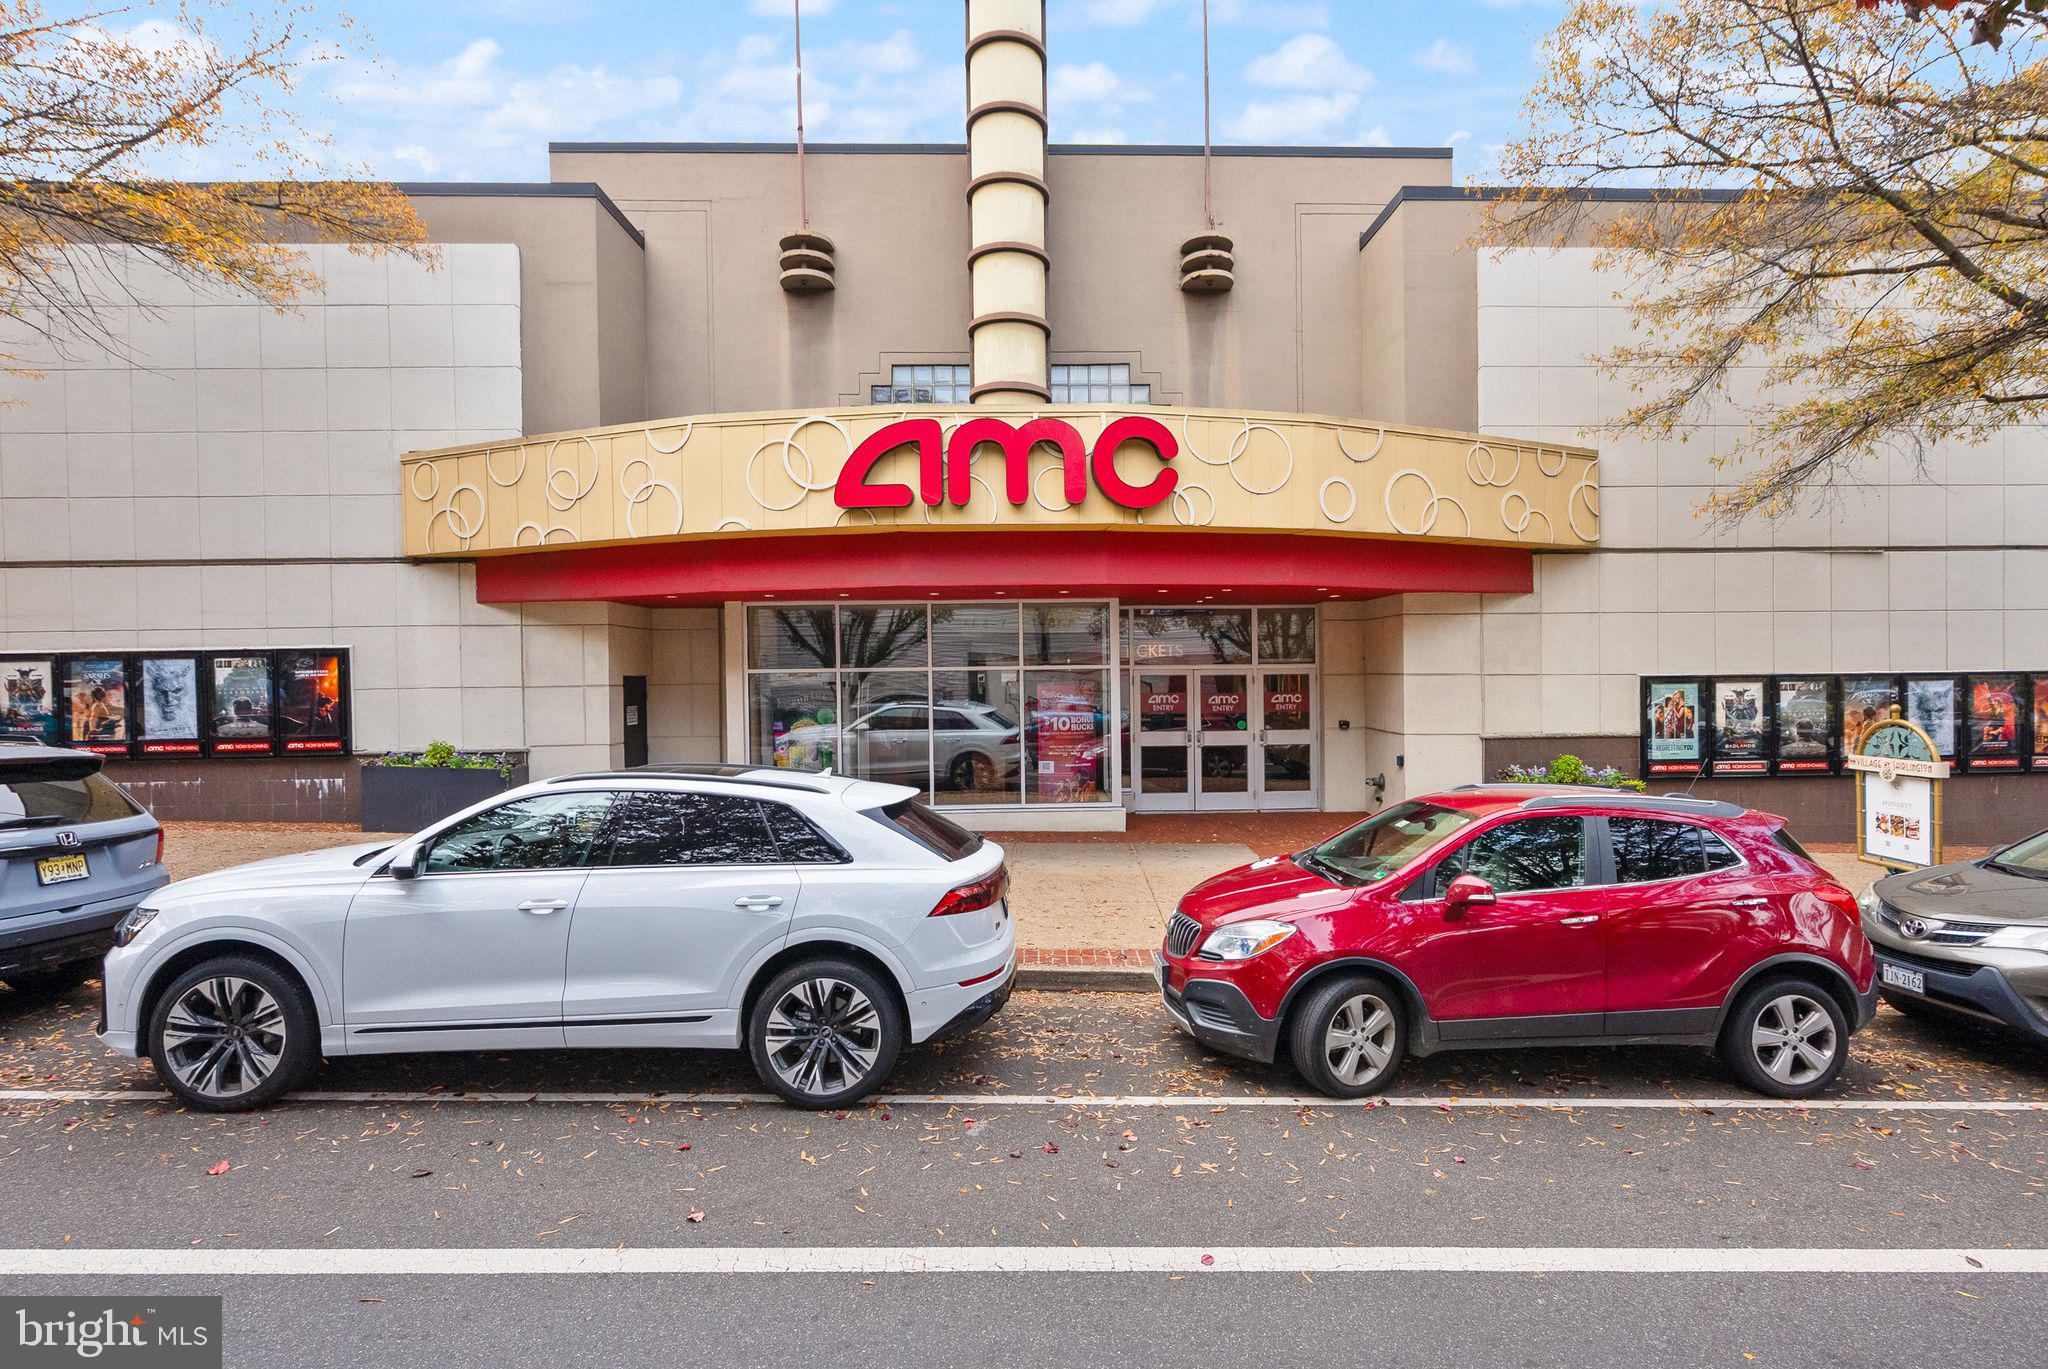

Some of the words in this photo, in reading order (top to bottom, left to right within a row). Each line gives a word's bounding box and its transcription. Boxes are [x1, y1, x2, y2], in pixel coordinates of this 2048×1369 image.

[1122, 644, 1184, 658] TCKETS
[1275, 703, 1297, 711] ENTRY
[1042, 716, 1071, 731] $10
[1071, 723, 1094, 731] BUCKS
[1856, 759, 1882, 768] VILLAGE
